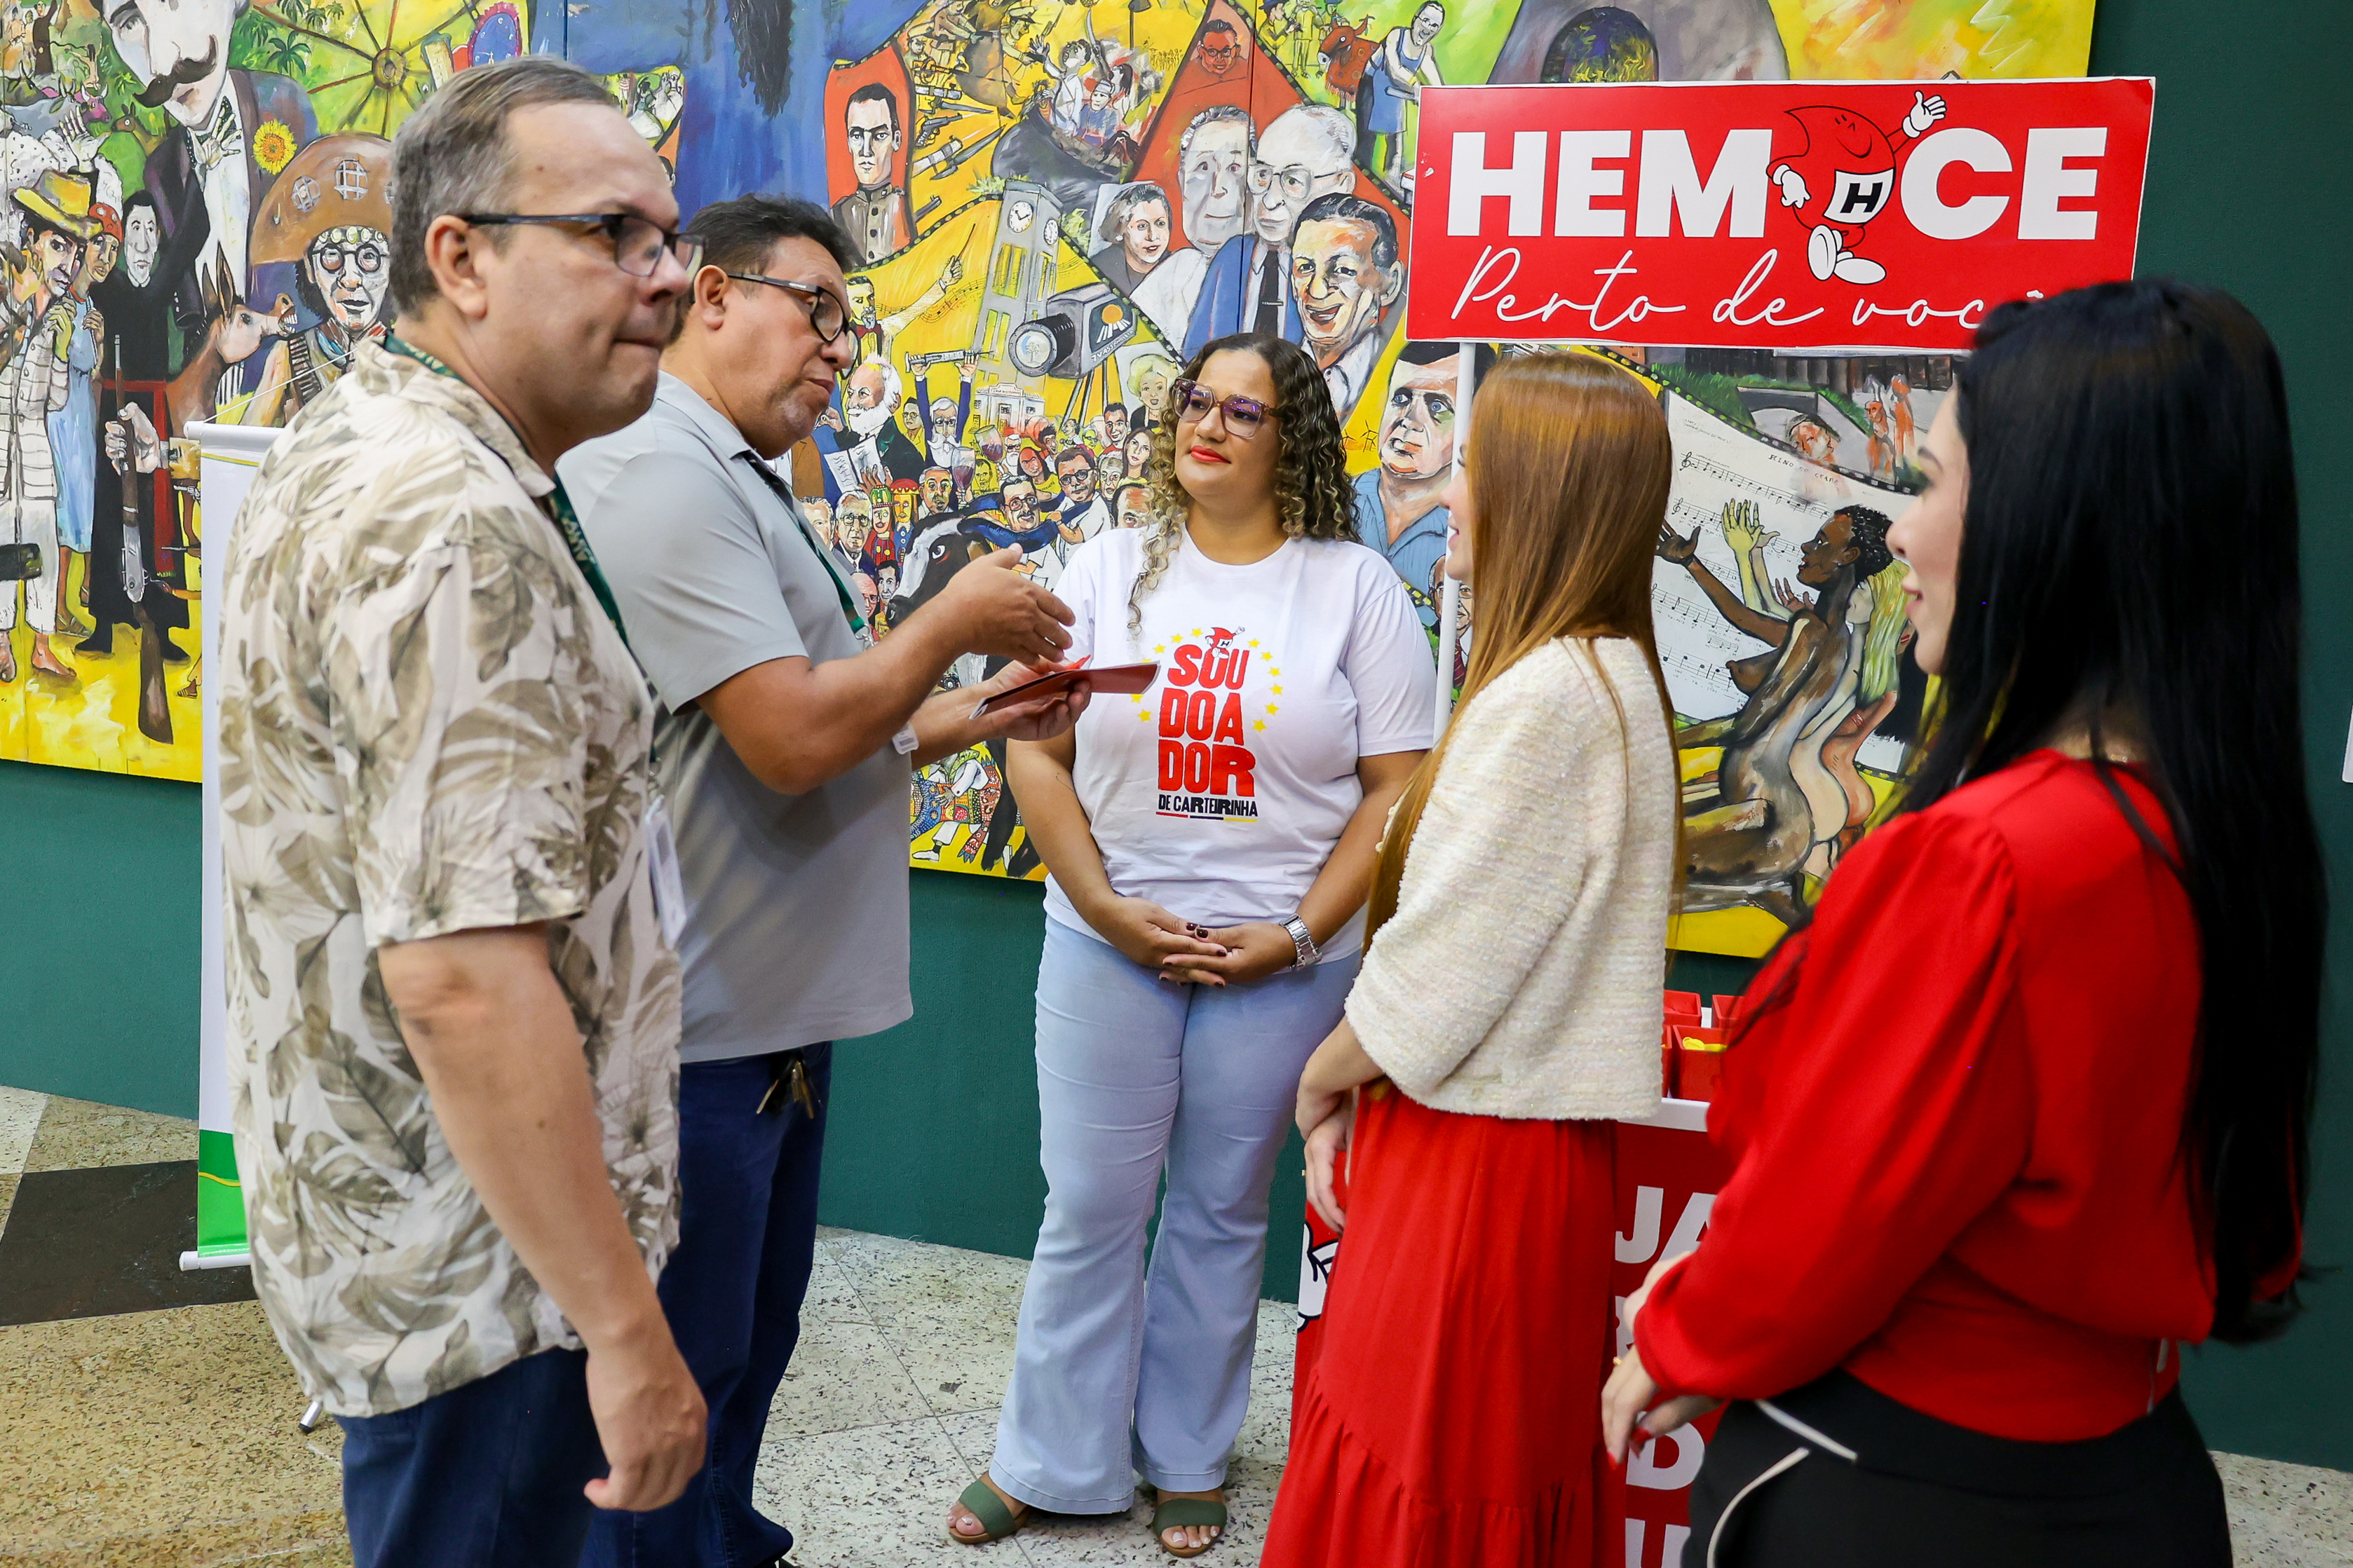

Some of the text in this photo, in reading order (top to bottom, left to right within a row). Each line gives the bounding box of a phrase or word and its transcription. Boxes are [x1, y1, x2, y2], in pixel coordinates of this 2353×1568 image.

[1451, 245, 1686, 331] Perto
[1713, 248, 1825, 326] de
[1768, 454, 1793, 468] HINO
[1167, 644, 1250, 690] SOU
[1158, 688, 1245, 746] DOA
[1158, 739, 1256, 797] DOR
[1158, 794, 1258, 817] DE CARTEIRINHA
